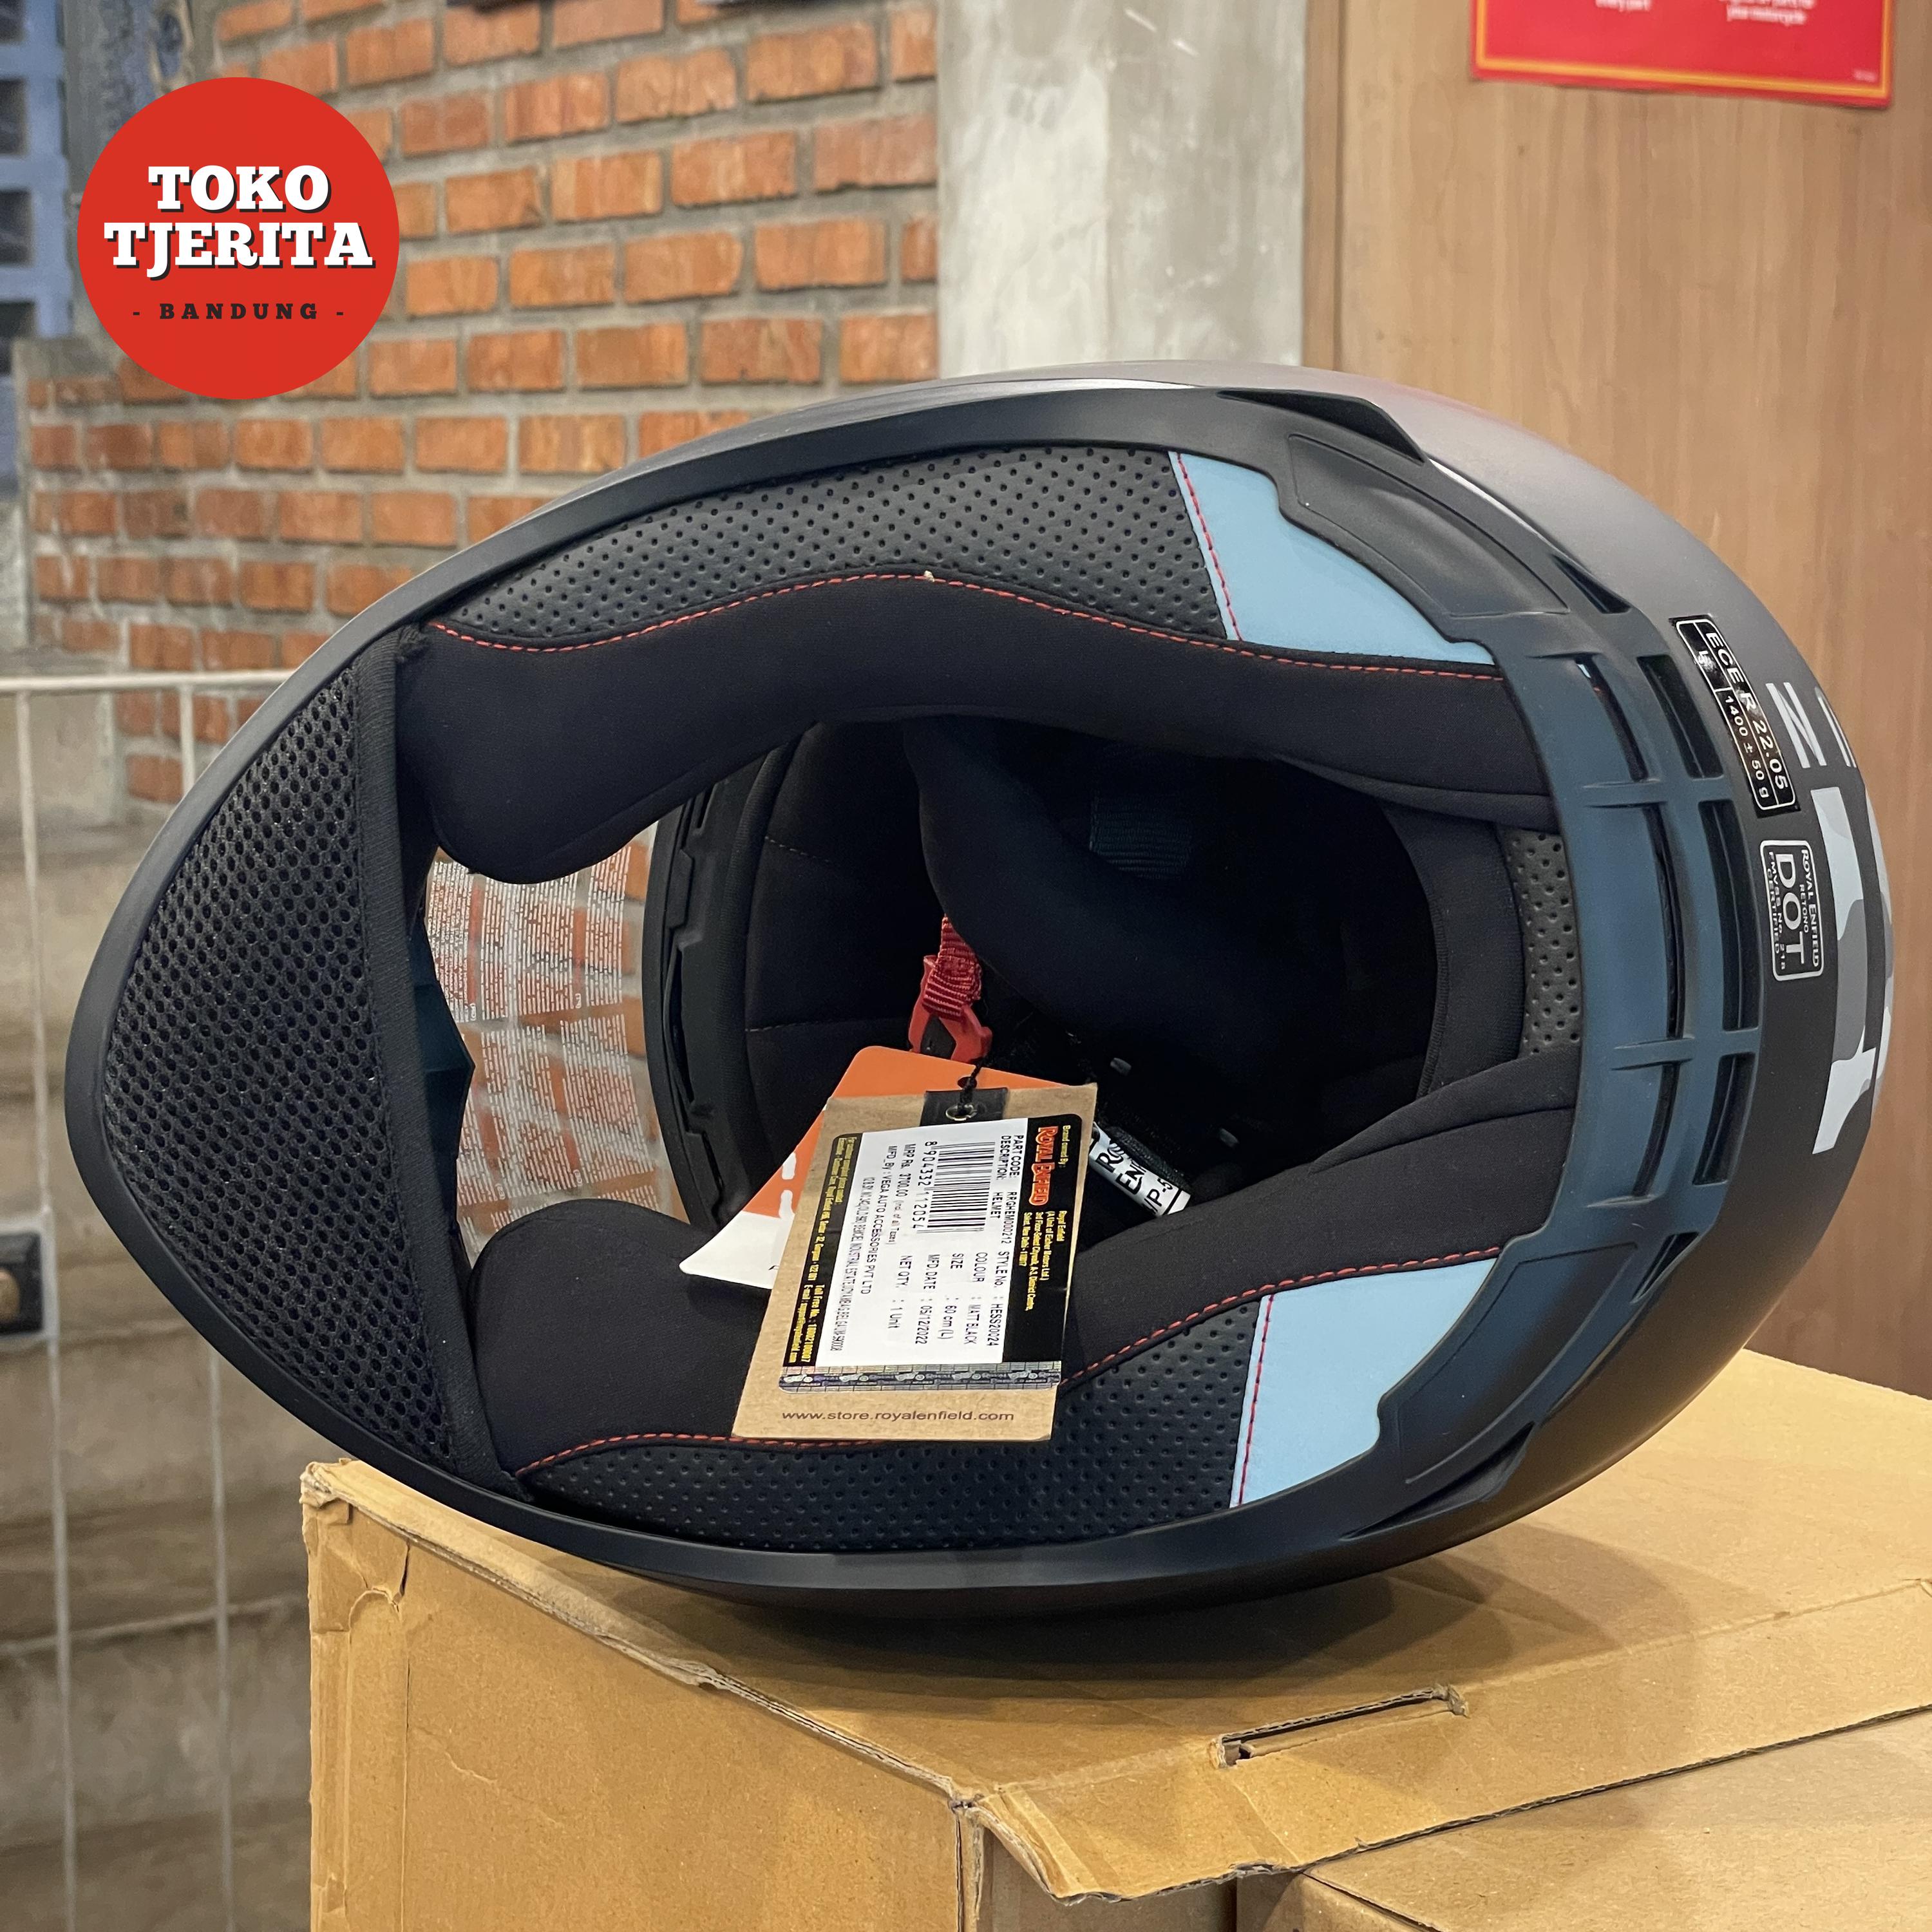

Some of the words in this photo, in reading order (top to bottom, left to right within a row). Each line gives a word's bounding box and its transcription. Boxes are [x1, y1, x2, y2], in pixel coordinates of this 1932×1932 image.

[1706, 632, 1744, 684] ECE
[1741, 692, 1757, 711] R
[1753, 720, 1788, 790] 22.05
[1725, 696, 1748, 736] 1400
[1751, 759, 1765, 781] 50
[1776, 853, 1804, 964] DOT
[1799, 884, 1809, 933] RETONO
[1801, 849, 1814, 900] ROYAL
[1808, 904, 1819, 967] ENFIELD
[902, 1143, 916, 1158] MRP
[1011, 1133, 1024, 1154] PART
[1032, 1125, 1058, 1162] ROYAL
[995, 1135, 1012, 1180] DESCRIPTION:
[1009, 1155, 1021, 1178] CODE:
[879, 1175, 892, 1193] VEGA
[895, 1172, 911, 1197] 3700.00
[1026, 1161, 1056, 1206] ENFIELD
[875, 1194, 888, 1213] AUTO
[989, 1191, 1004, 1219] HELMET
[1001, 1191, 1018, 1244] RRGHEM000212
[866, 1214, 885, 1262] ACCESSORIES
[862, 1265, 875, 1278] PVT
[898, 1255, 913, 1269] NET
[925, 1254, 940, 1270] MFD.
[950, 1253, 964, 1269] SIZE
[972, 1251, 988, 1282] COLOUR
[994, 1251, 1010, 1274] STYLE
[859, 1280, 873, 1294] LTD
[895, 1271, 910, 1287] QTY.
[922, 1271, 938, 1289] DATE
[993, 1275, 1007, 1288] No.
[943, 1305, 957, 1314] 60
[966, 1304, 981, 1321] MATT
[887, 1313, 902, 1329] Unit
[914, 1305, 933, 1345] 05/12/2022
[942, 1315, 953, 1327] cm
[986, 1303, 1003, 1346] HESS20024
[936, 1329, 954, 1340] (L)
[963, 1323, 979, 1345] BLACK
[782, 1410, 1014, 1422] www.store.royalenfield.com
